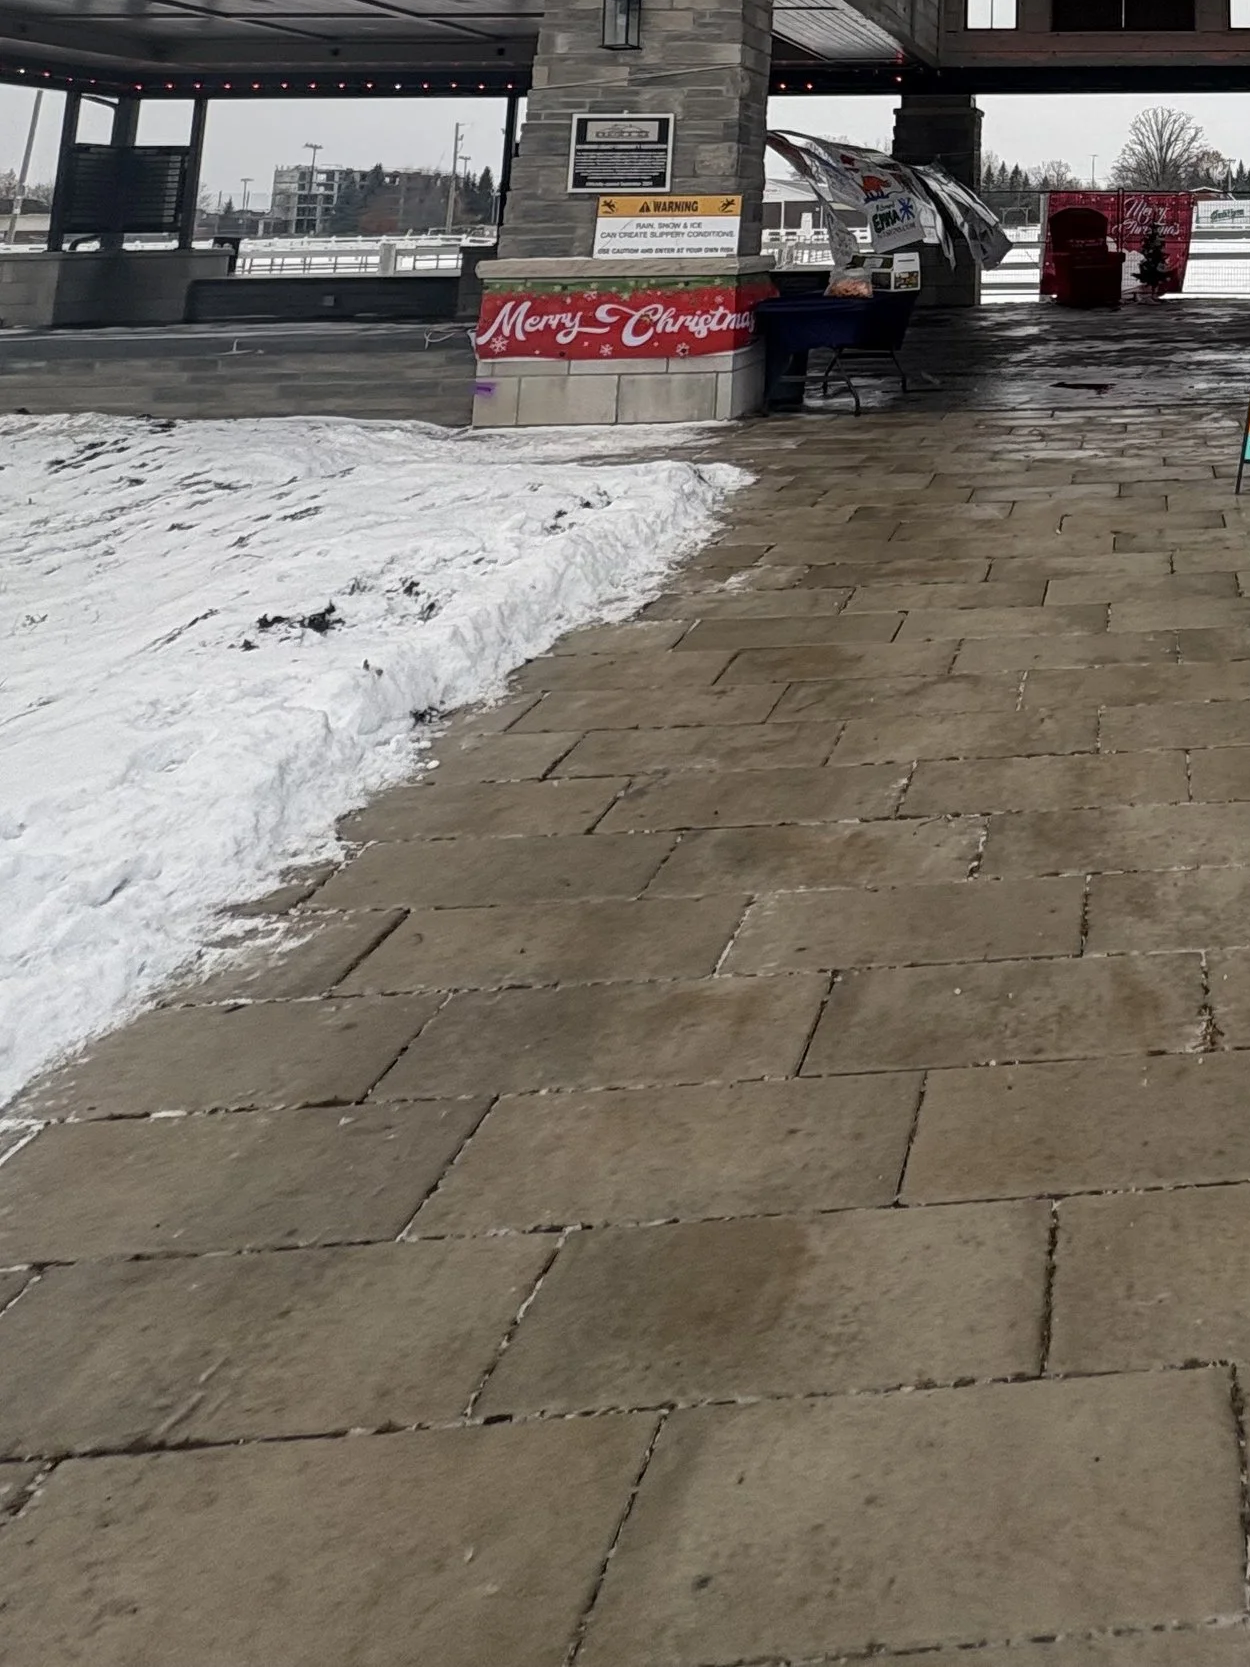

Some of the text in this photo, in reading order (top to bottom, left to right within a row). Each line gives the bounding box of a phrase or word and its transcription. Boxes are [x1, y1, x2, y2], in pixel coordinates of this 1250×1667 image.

[653, 201, 698, 212] WARNING
[600, 231, 617, 239] CAN
[477, 300, 610, 344] Merry
